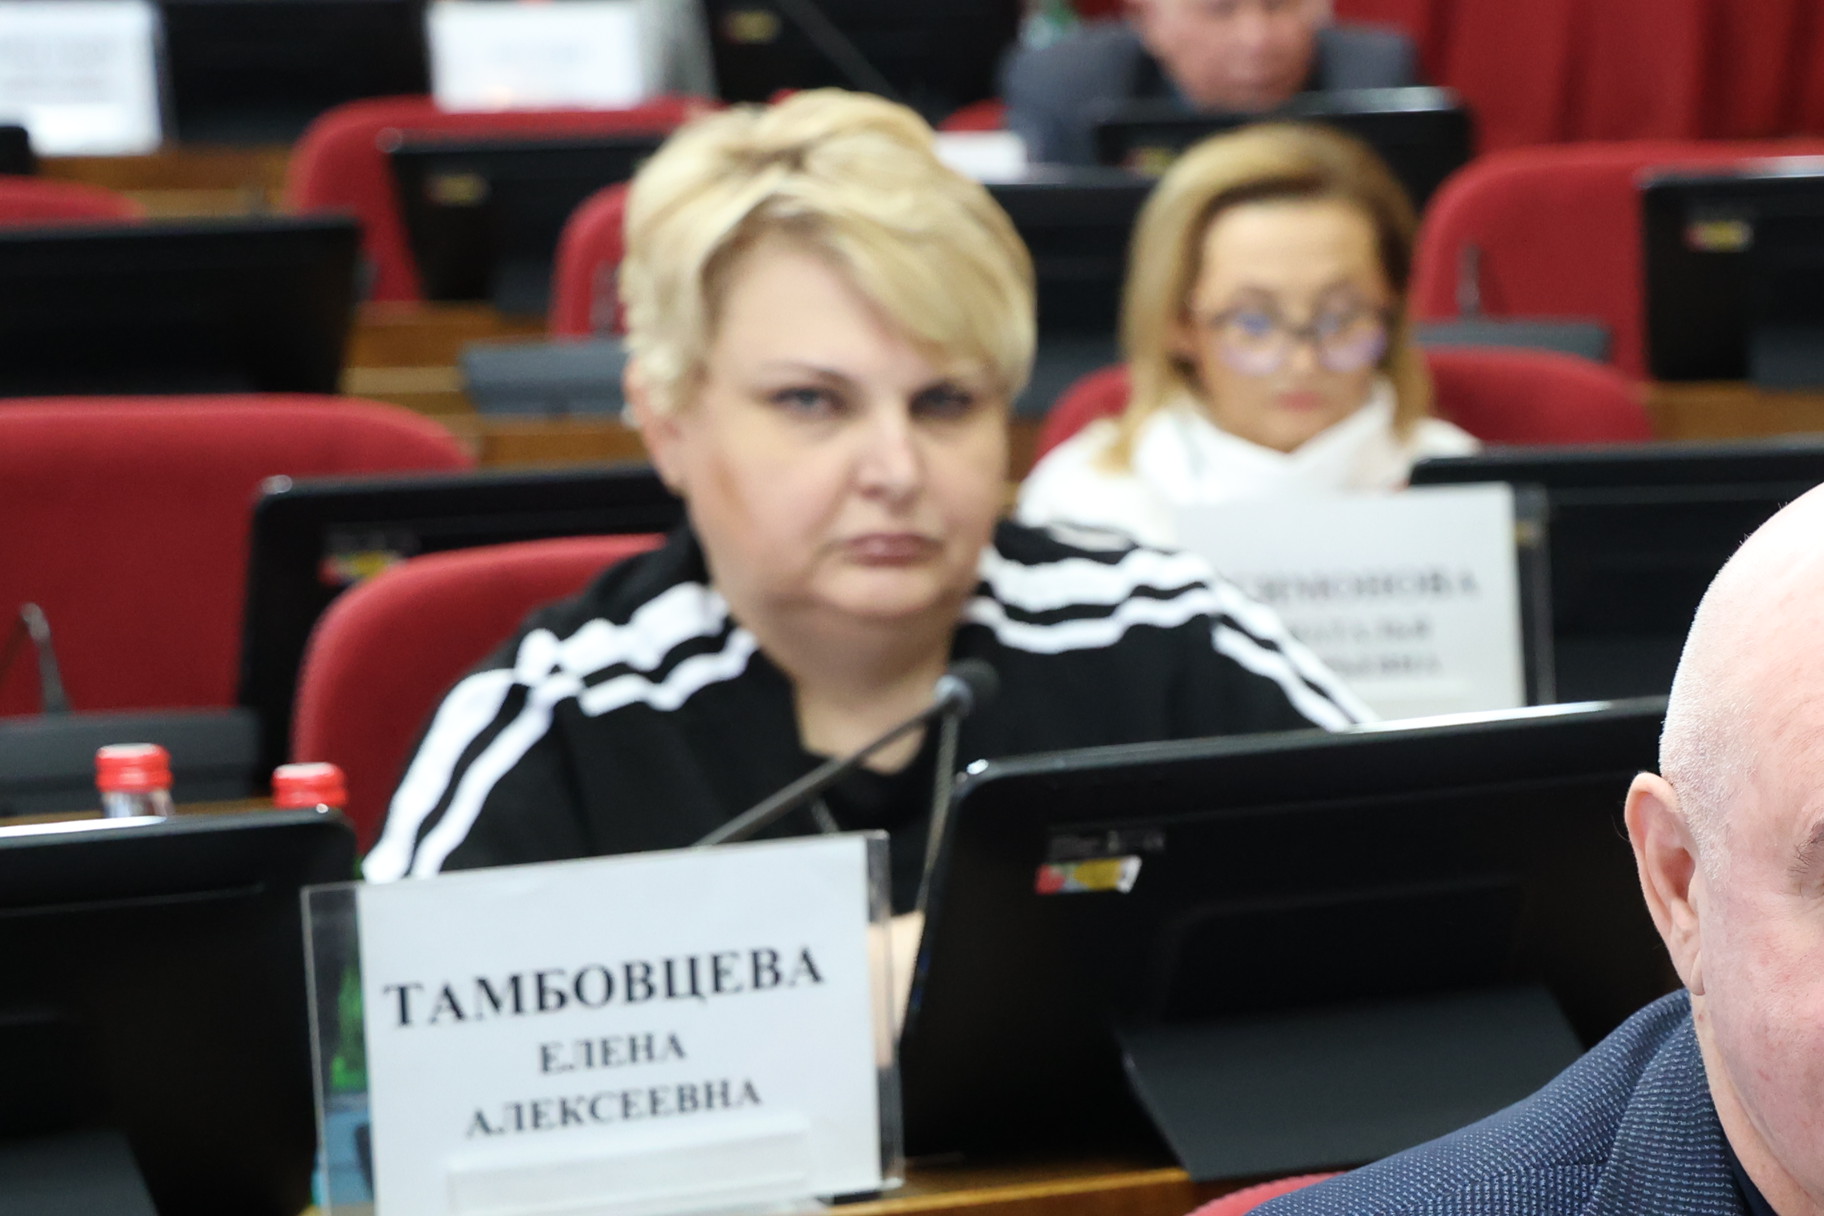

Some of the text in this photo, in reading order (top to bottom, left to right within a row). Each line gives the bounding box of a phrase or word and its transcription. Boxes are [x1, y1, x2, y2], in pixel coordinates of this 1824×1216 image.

[384, 945, 825, 1027] ТАМБОВЦЕВА
[539, 1033, 687, 1074] ЕЛЕНА
[466, 1078, 762, 1137] АЛЕКСЕЕВНА
